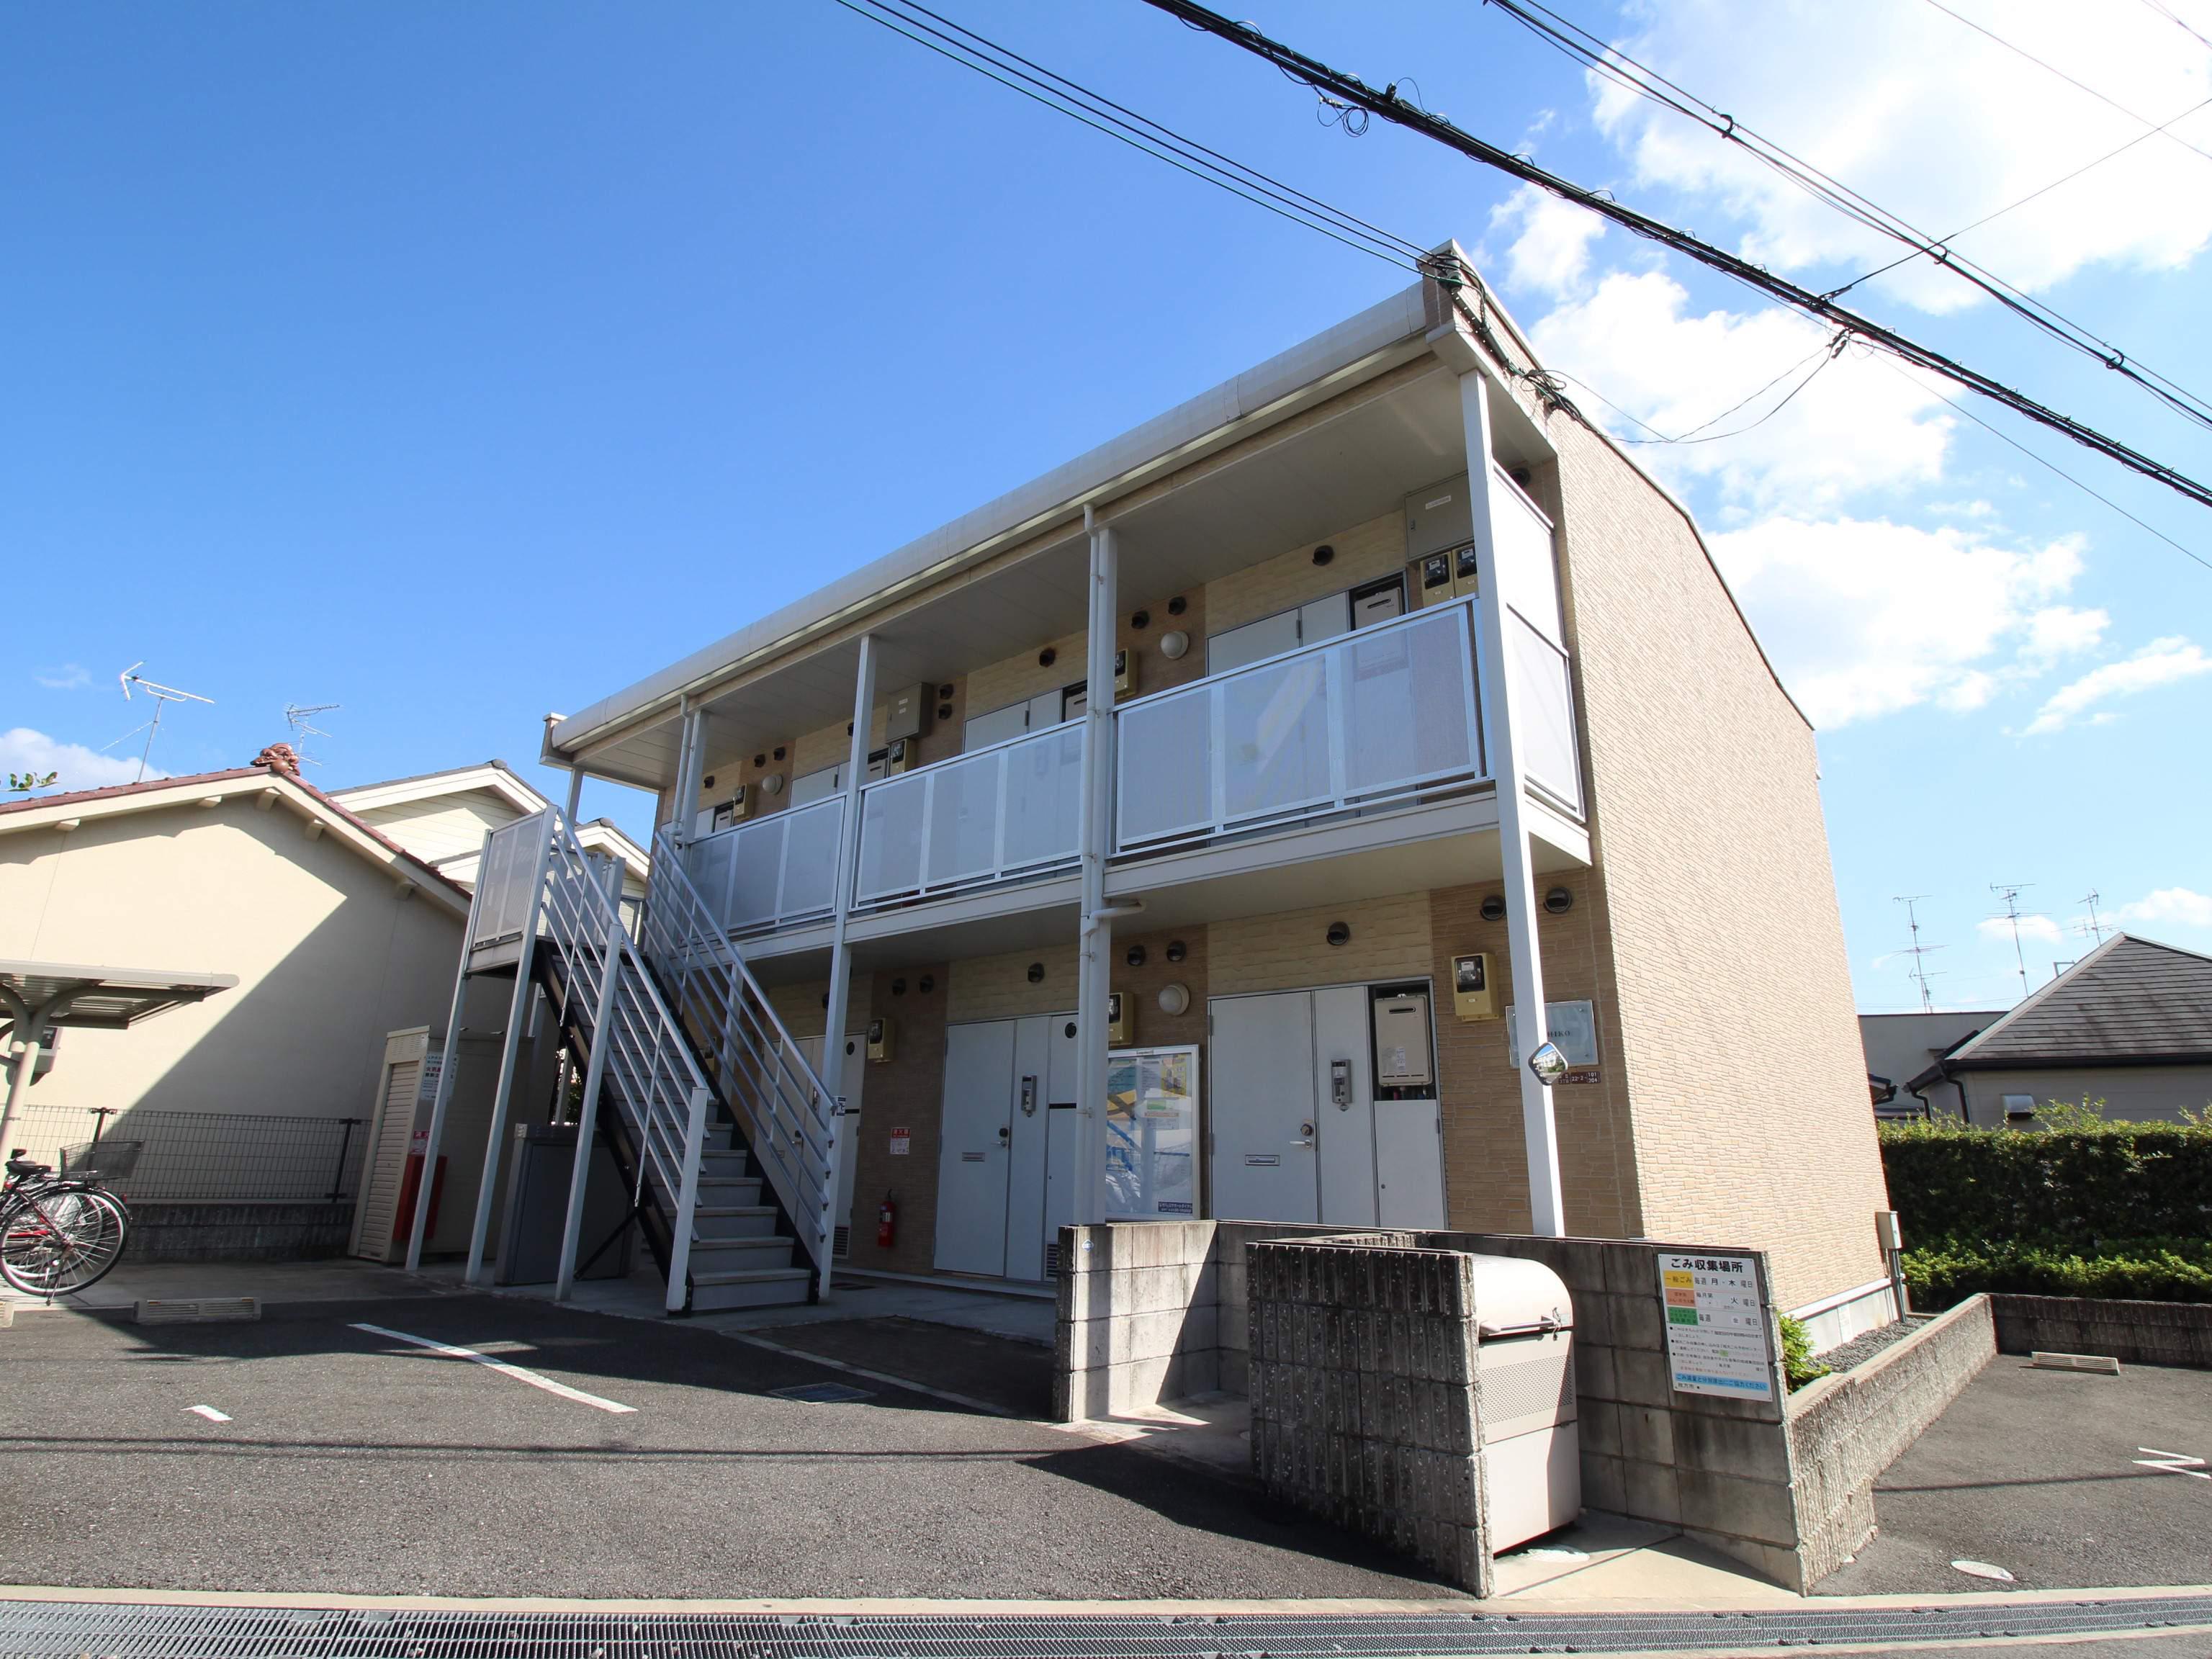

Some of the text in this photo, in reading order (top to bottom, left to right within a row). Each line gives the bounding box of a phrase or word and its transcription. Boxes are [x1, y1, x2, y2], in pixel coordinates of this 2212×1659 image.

[1671, 1258, 1743, 1273] ごみ収集場所
